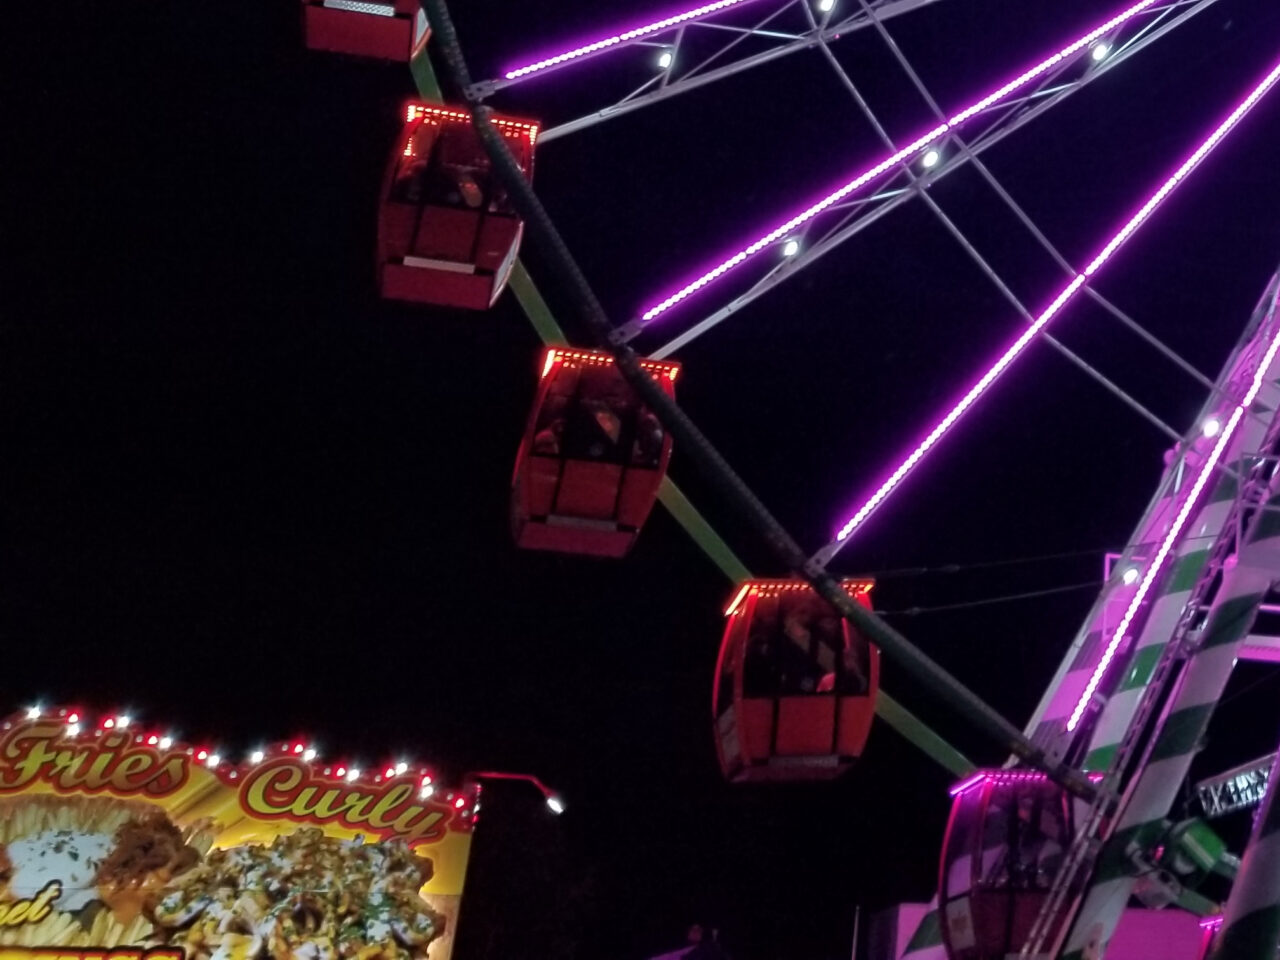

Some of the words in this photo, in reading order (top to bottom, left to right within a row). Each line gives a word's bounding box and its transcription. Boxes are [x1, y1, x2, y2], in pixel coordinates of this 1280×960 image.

[0, 724, 184, 791] Fries
[247, 765, 443, 842] Curly
[0, 882, 60, 925] et
